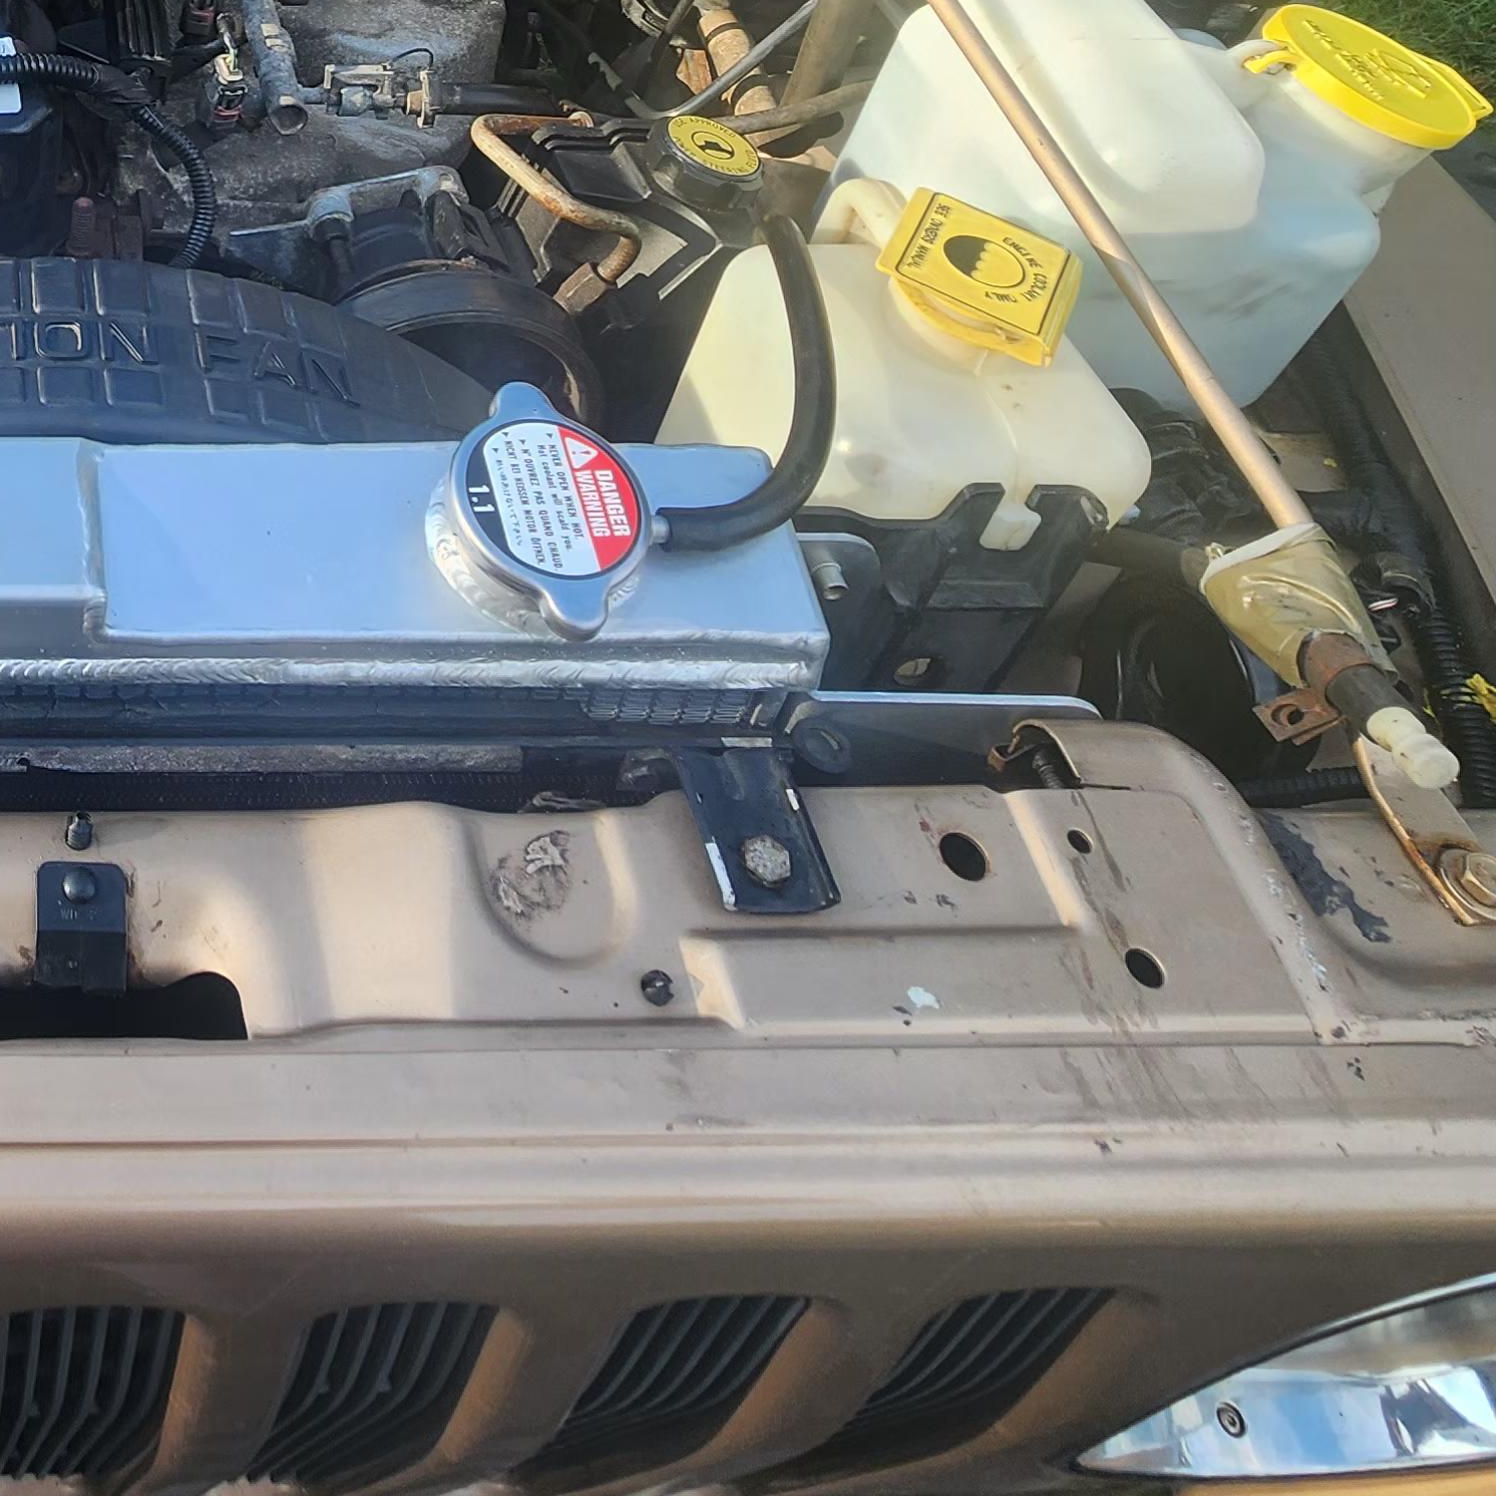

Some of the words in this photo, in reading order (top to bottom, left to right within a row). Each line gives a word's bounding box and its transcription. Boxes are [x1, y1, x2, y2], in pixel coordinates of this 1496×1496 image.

[1002, 236, 1043, 270] ENGINE
[984, 290, 1018, 303] ONLY
[1022, 272, 1048, 302] COOLANT
[198, 328, 361, 407] FAN
[549, 445, 562, 467] NEVER
[556, 471, 569, 491] OPEN
[564, 495, 577, 518] WHEN
[468, 485, 496, 512] 1.1
[533, 490, 546, 505] PAS
[574, 469, 611, 537] WARNING
[594, 470, 631, 536] DANGER
[524, 509, 537, 533] MOTOR
[539, 510, 554, 537] QUAND
